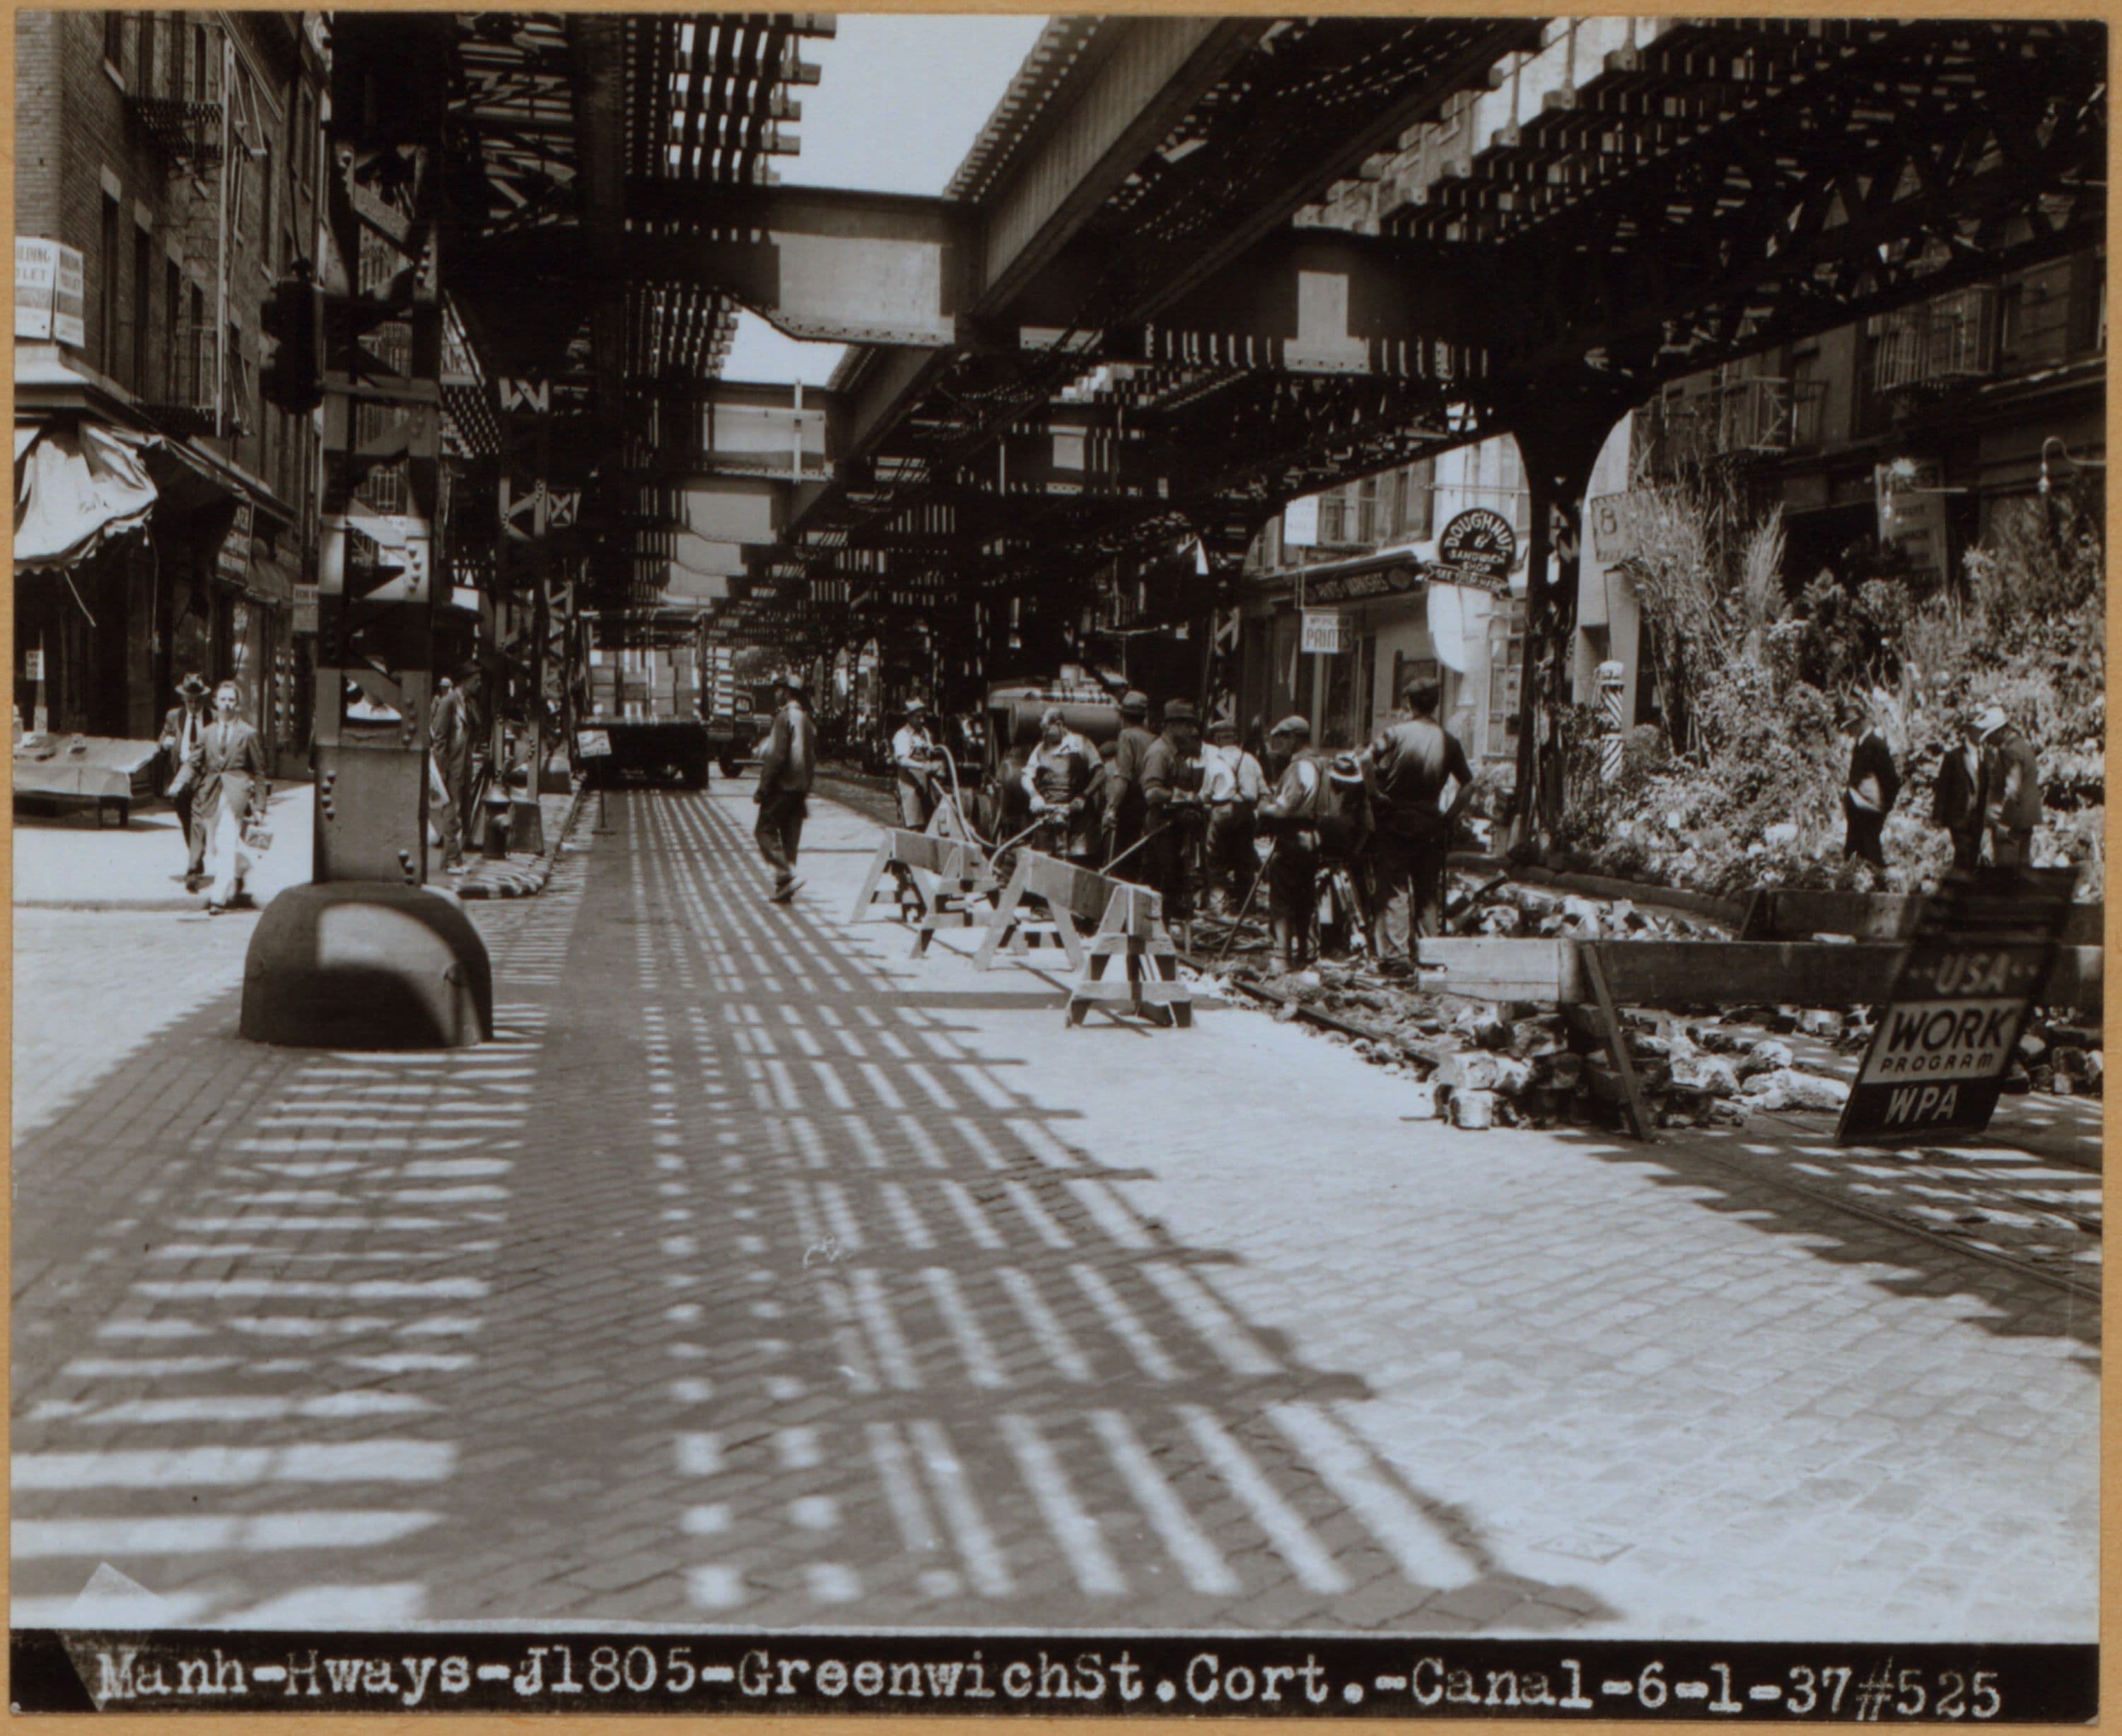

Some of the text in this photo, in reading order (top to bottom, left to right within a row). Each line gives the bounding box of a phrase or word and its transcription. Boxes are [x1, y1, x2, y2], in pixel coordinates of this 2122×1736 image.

[1444, 511, 1512, 552] DOUGHNUT
[1447, 549, 1505, 565] SANDWICH
[1462, 561, 1491, 572] SHOP
[1306, 628, 1351, 648] PAINTS
[1936, 953, 2010, 994] USA
[1887, 1007, 2017, 1052] WORK
[1880, 1053, 1994, 1073] PROGRAM
[1884, 1084, 1960, 1125] WPA
